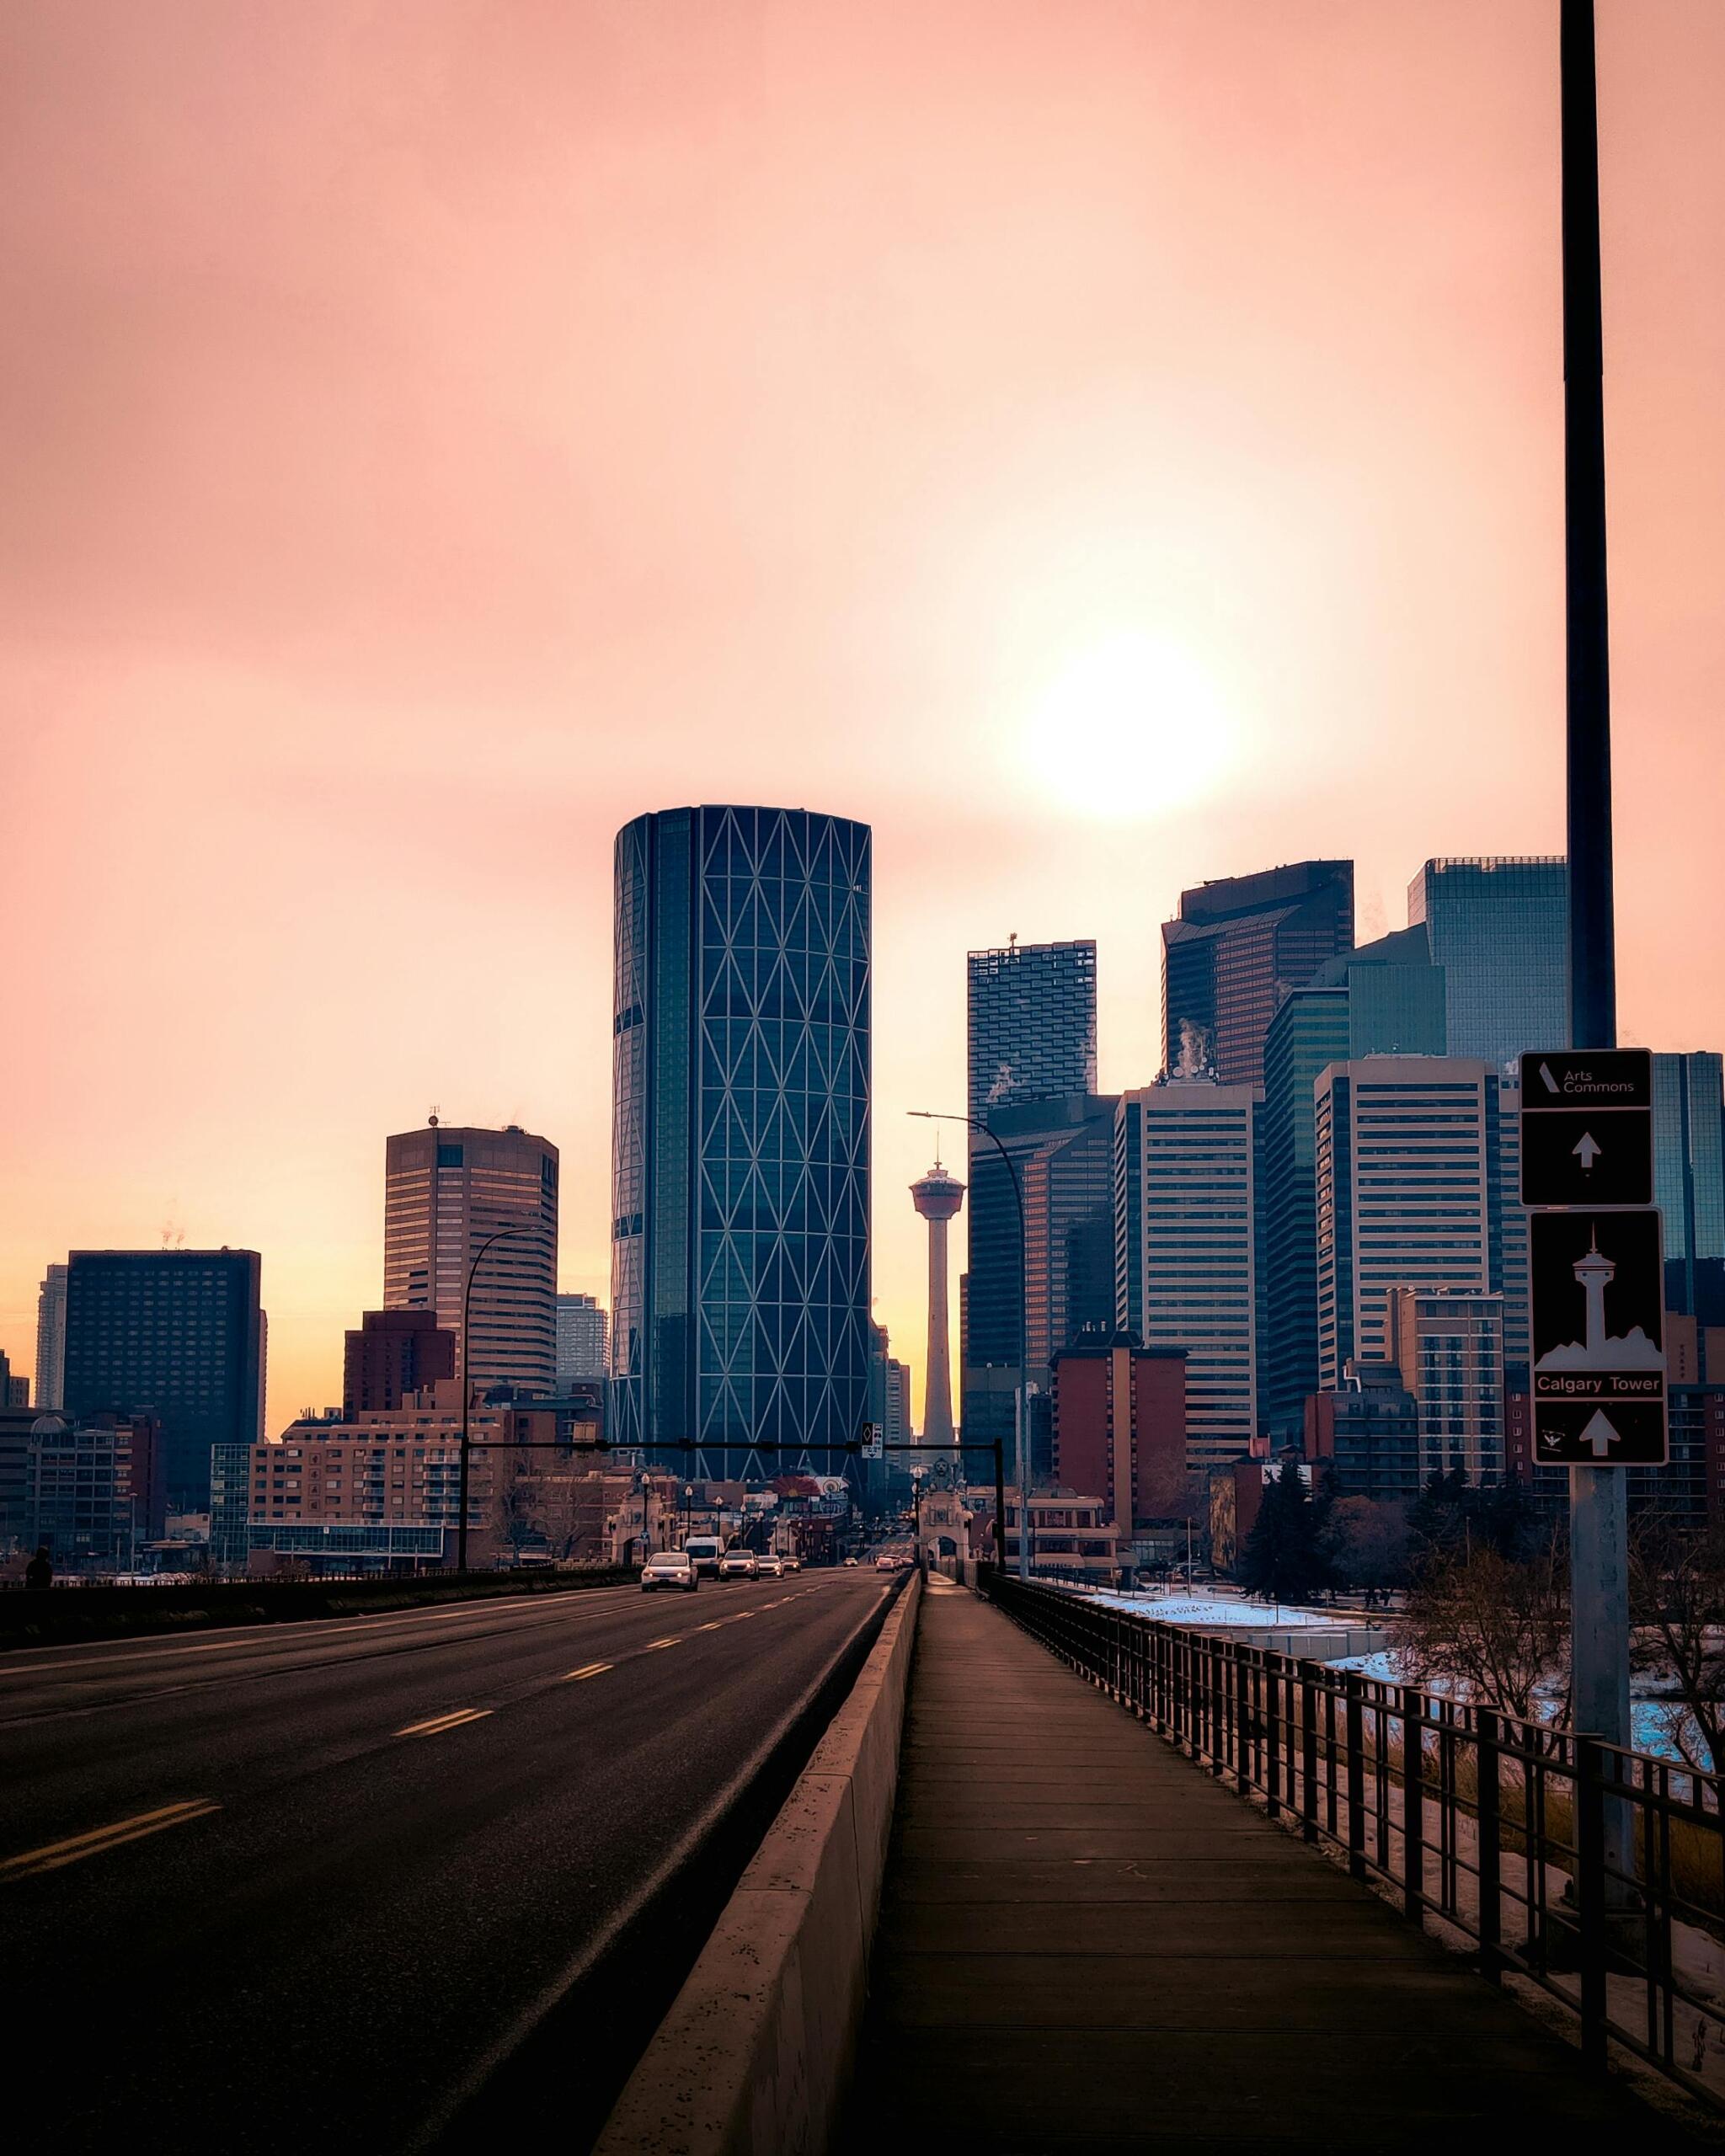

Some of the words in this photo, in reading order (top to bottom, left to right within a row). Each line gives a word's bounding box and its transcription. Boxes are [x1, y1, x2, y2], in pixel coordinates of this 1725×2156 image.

[1563, 1070, 1593, 1081] Arts
[1563, 1081, 1635, 1093] Commons
[1537, 1376, 1602, 1393] Calgary
[1609, 1376, 1660, 1390] Tower
